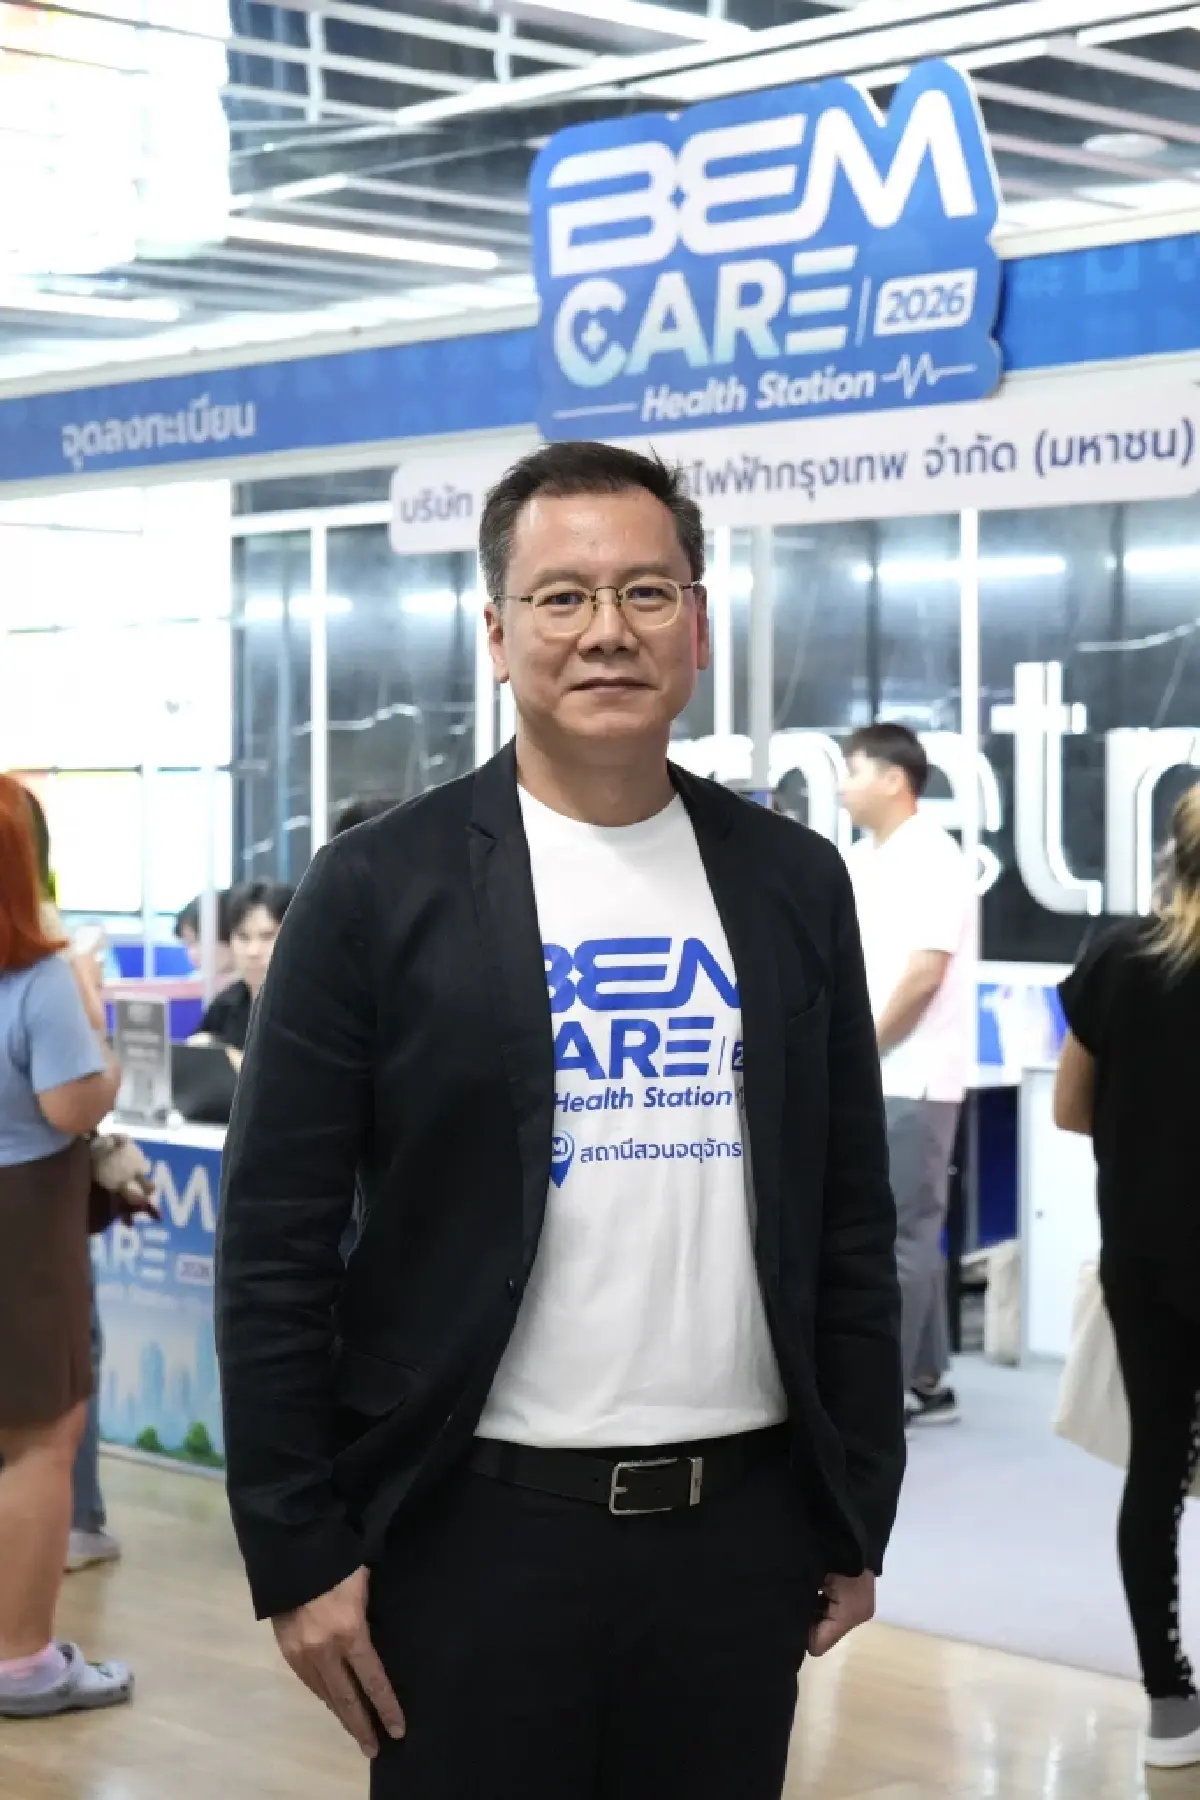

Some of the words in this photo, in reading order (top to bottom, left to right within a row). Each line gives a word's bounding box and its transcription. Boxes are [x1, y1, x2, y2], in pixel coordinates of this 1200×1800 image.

[548, 89, 978, 278] BEM
[553, 244, 858, 388] CARE
[882, 280, 967, 326] 2026
[641, 375, 747, 422] Health
[757, 364, 876, 410] Station
[61, 392, 257, 472] จุดลงทะเบียน
[400, 482, 474, 524] บริษัท
[679, 450, 909, 502] ไฟฟ้ากรุงเทพ
[922, 431, 1018, 479] จำกัด
[1034, 416, 1196, 479] (มหาชน)
[553, 1016, 714, 1081] ARE
[554, 1087, 634, 1113] Health
[643, 1085, 734, 1108] Station
[579, 1137, 743, 1164] สถานีสวนจตุจักร
